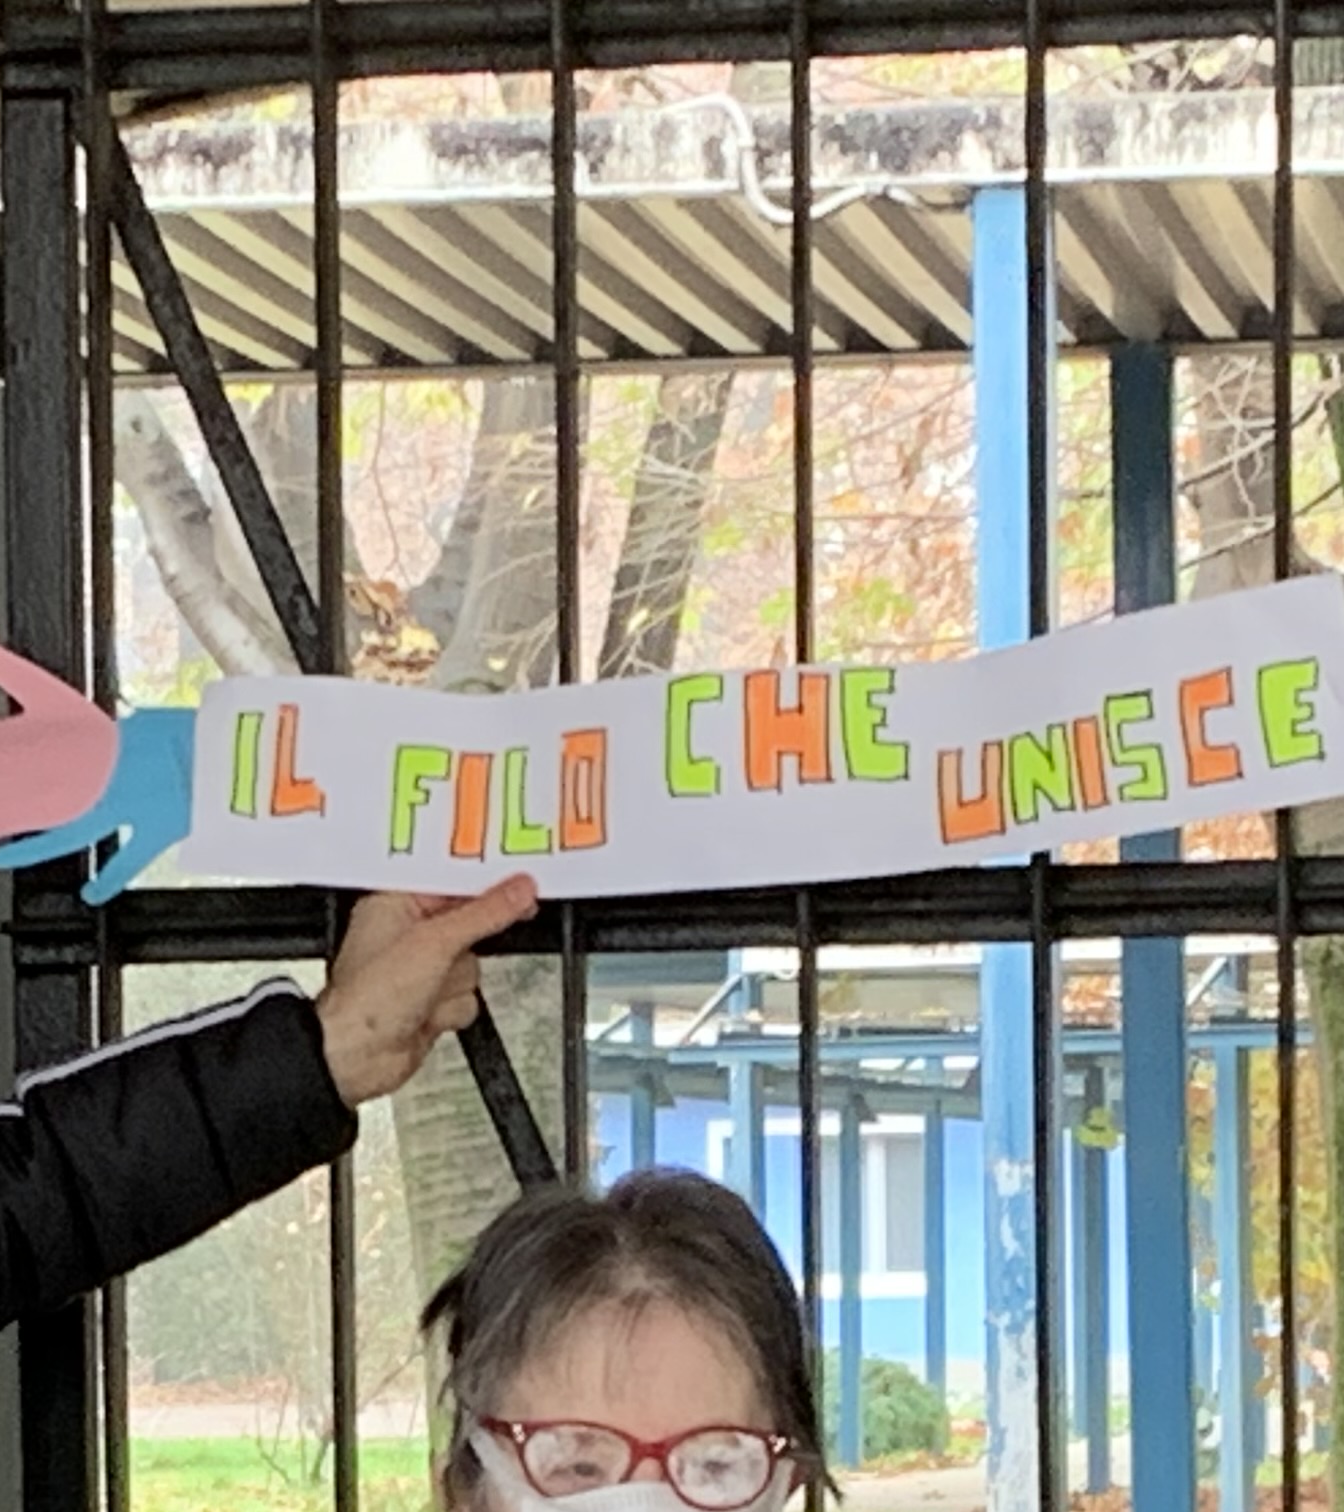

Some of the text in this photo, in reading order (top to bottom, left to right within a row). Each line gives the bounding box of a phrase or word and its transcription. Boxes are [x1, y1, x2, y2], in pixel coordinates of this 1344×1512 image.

[229, 657, 1326, 862] IL FILO CHE UNISCE
